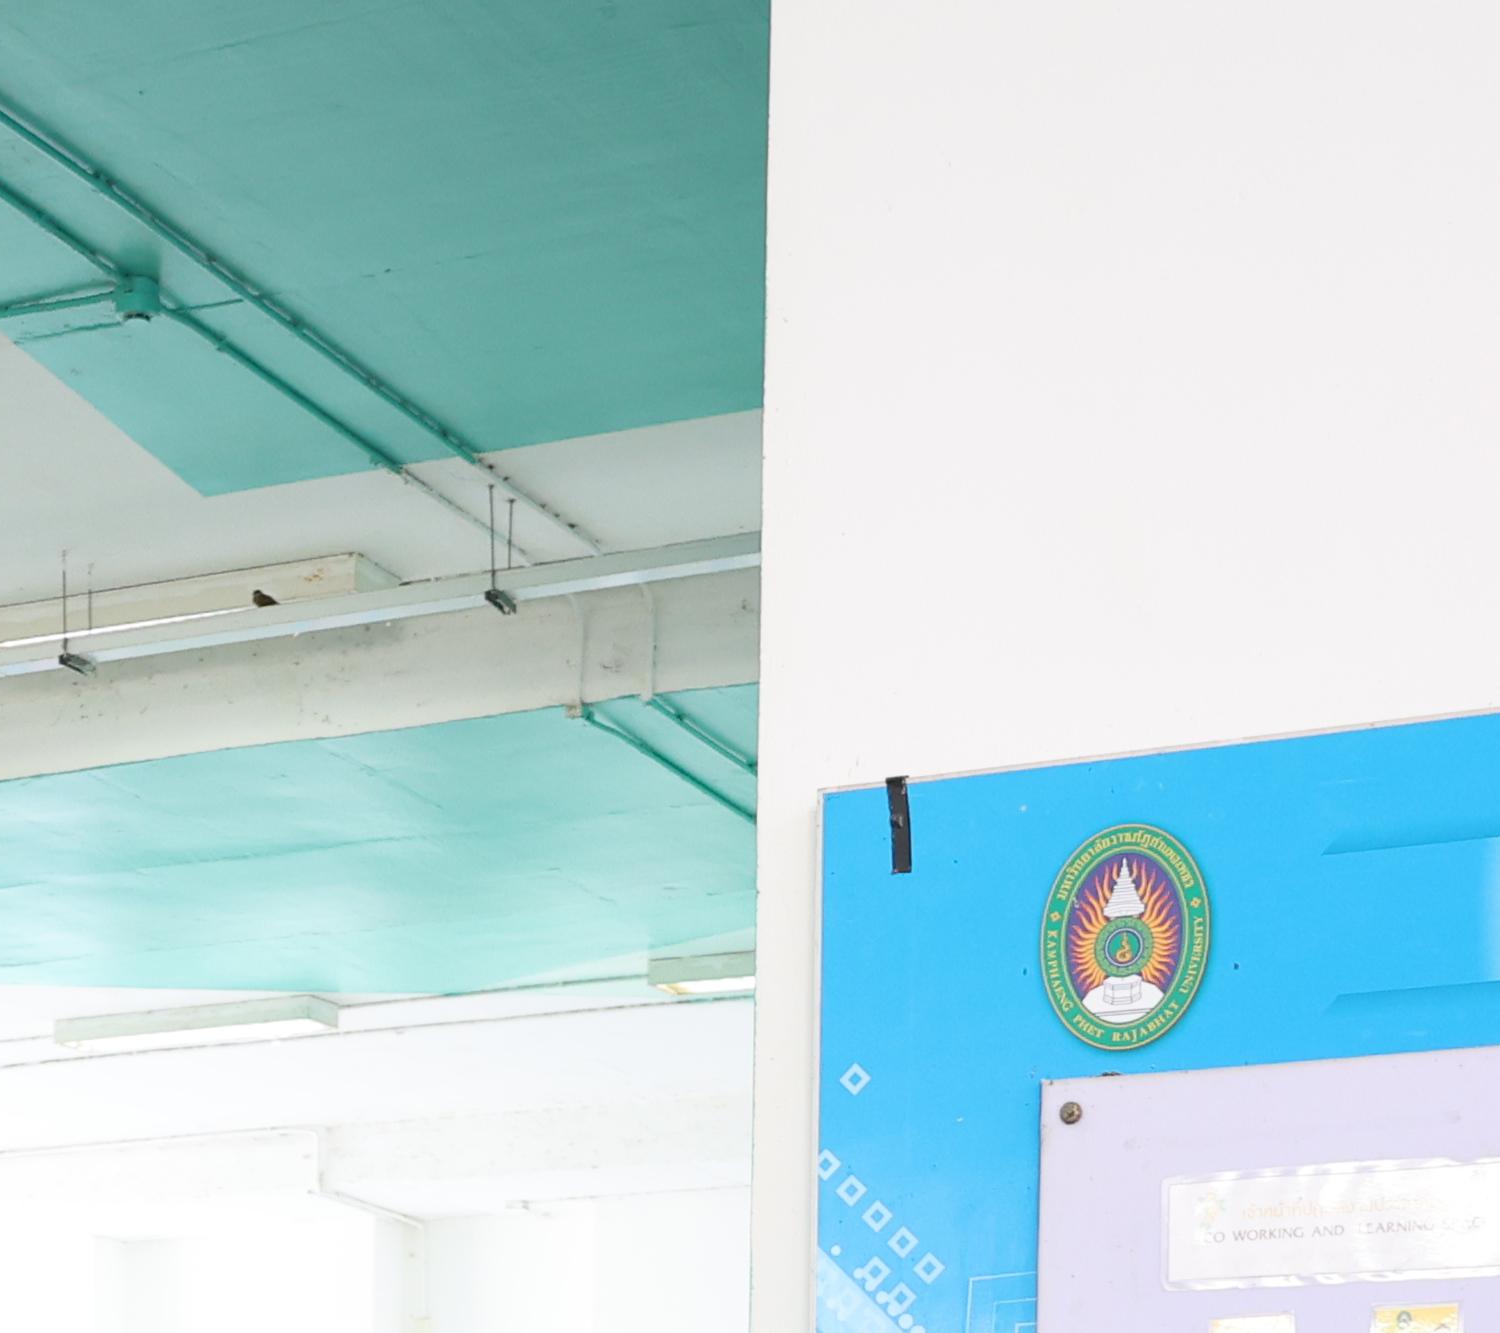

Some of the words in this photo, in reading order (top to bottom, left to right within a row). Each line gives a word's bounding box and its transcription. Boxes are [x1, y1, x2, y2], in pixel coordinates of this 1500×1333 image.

[1047, 930, 1074, 1012] KAMPHAENG
[1072, 1013, 1105, 1038] PHET
[1112, 1002, 1181, 1043] RAJABHAT
[1179, 916, 1204, 994] UNIVERSITY
[1232, 1227, 1304, 1242] WORKING
[1312, 1224, 1345, 1238] AND
